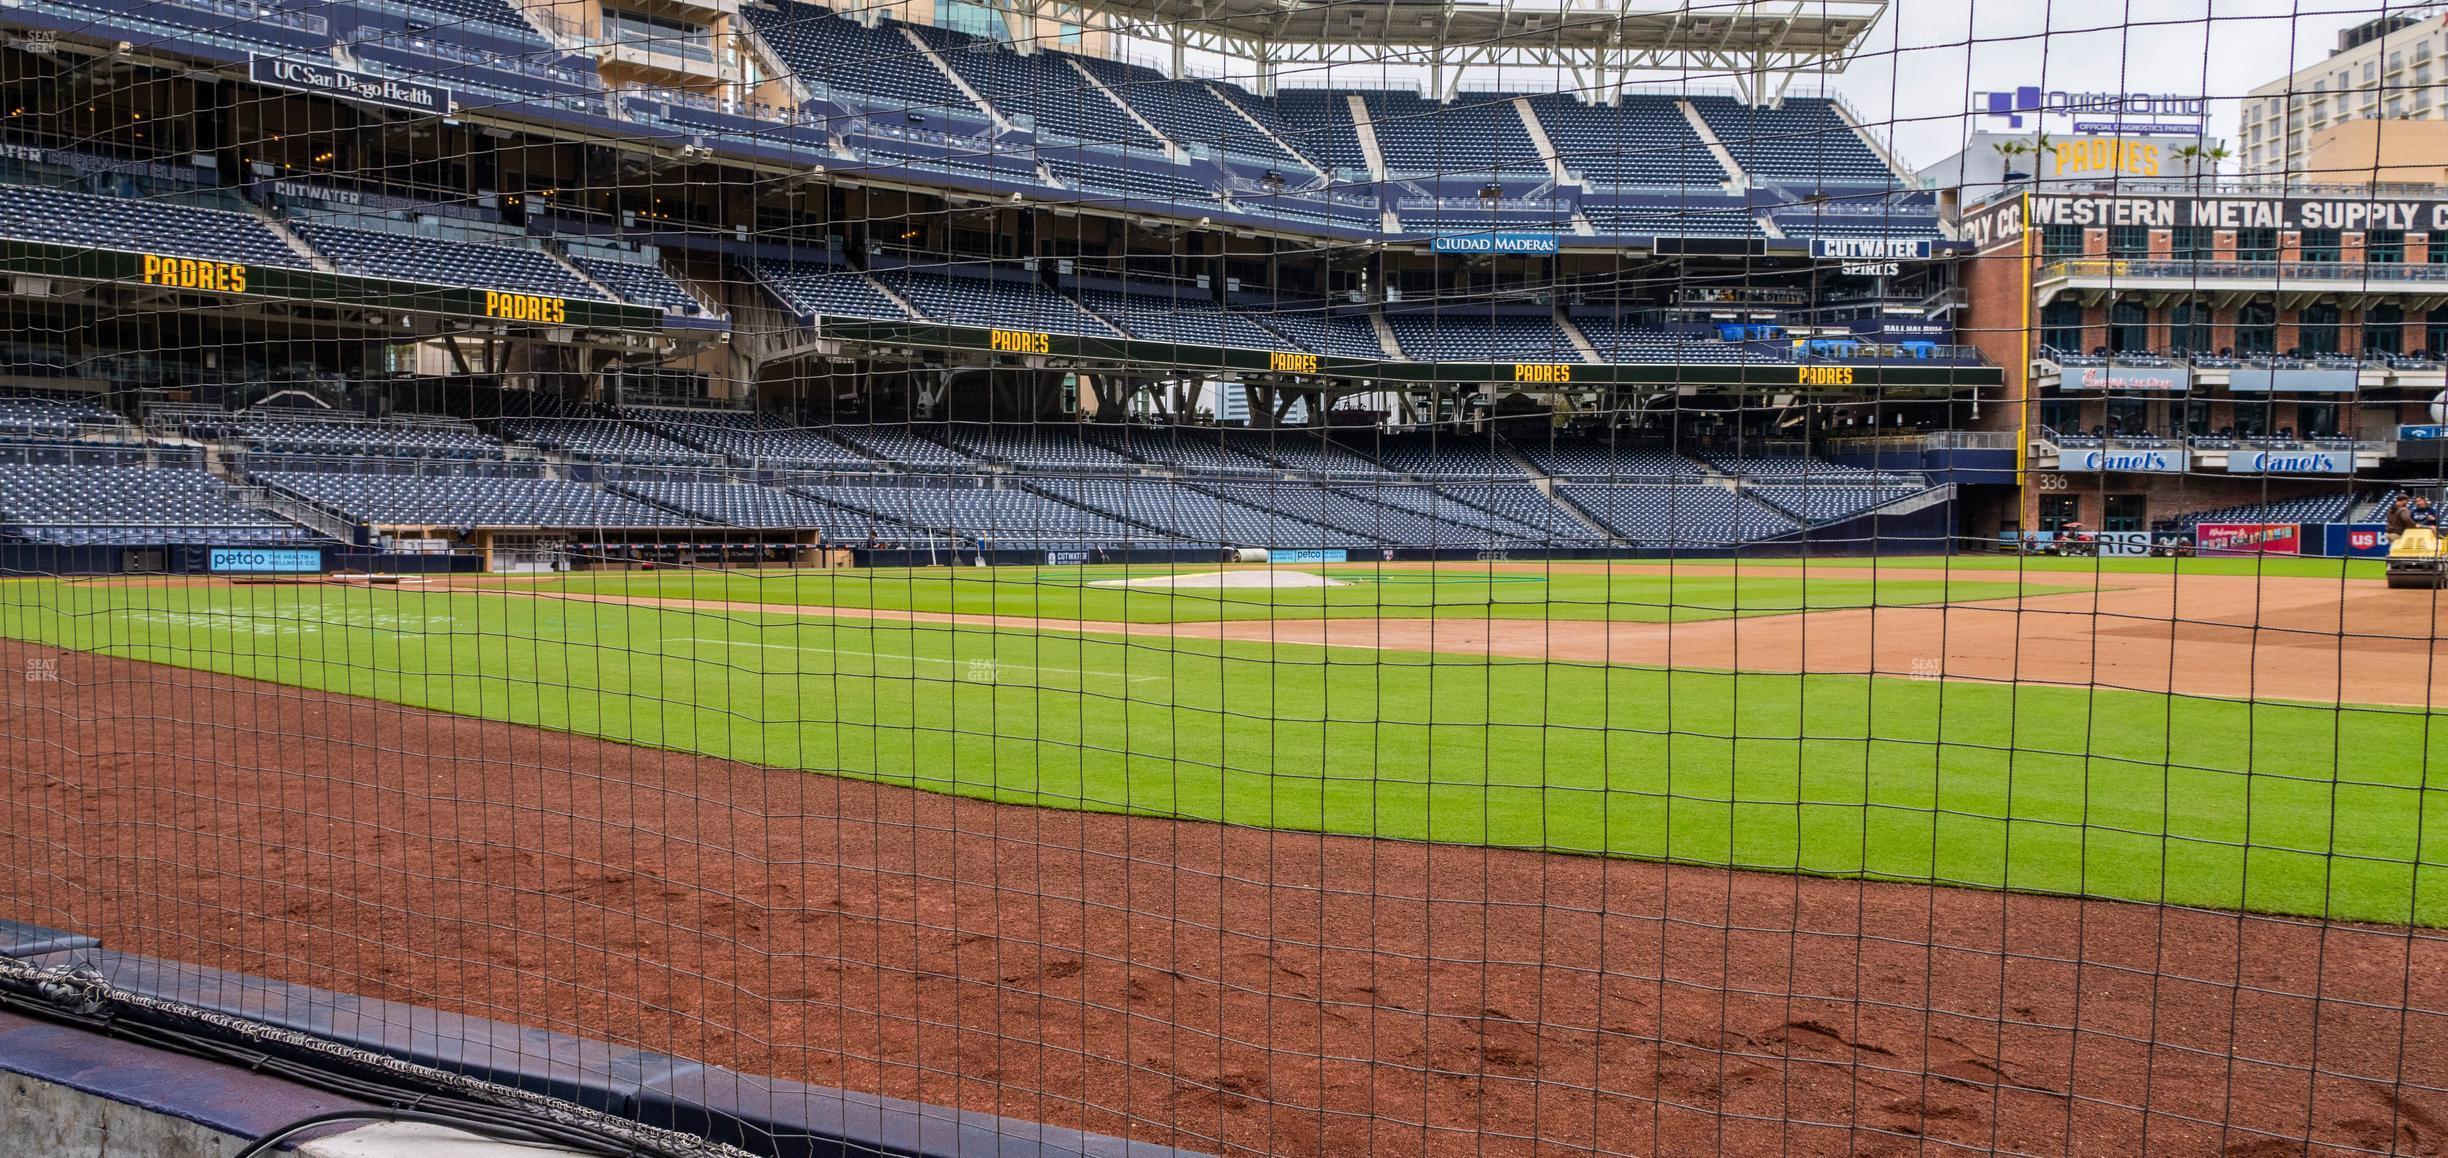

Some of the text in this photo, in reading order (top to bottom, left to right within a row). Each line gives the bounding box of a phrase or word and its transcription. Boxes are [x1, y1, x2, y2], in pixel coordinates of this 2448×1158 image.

[274, 61, 432, 106] UC San Diego Health
[2080, 123, 2198, 133] OFFICIAL DIAGNOSTICS PARTNER
[2055, 139, 2158, 176] PADRES
[275, 181, 360, 205] CUTWATER
[2028, 197, 2174, 226] WESTERN
[2190, 200, 2292, 228] METAL
[2301, 202, 2420, 230] SUPPLY
[1436, 237, 1554, 251] CIUDAD MADERAS
[1824, 240, 1918, 257] CUTWATER
[144, 255, 246, 293] PADRES
[1841, 262, 1899, 276] SPIRITS
[486, 291, 565, 323] PADRES
[991, 329, 1049, 353] PADRES
[1270, 351, 1317, 373] PADRES
[1515, 364, 1570, 382] PADRES
[1798, 367, 1853, 385] PADRES
[2085, 451, 2166, 470] Canel's
[2254, 452, 2334, 472] Canel's
[2040, 474, 2068, 490] 336
[2351, 534, 2373, 545] us
[214, 552, 265, 568] petco
[1297, 550, 1320, 559] petco
